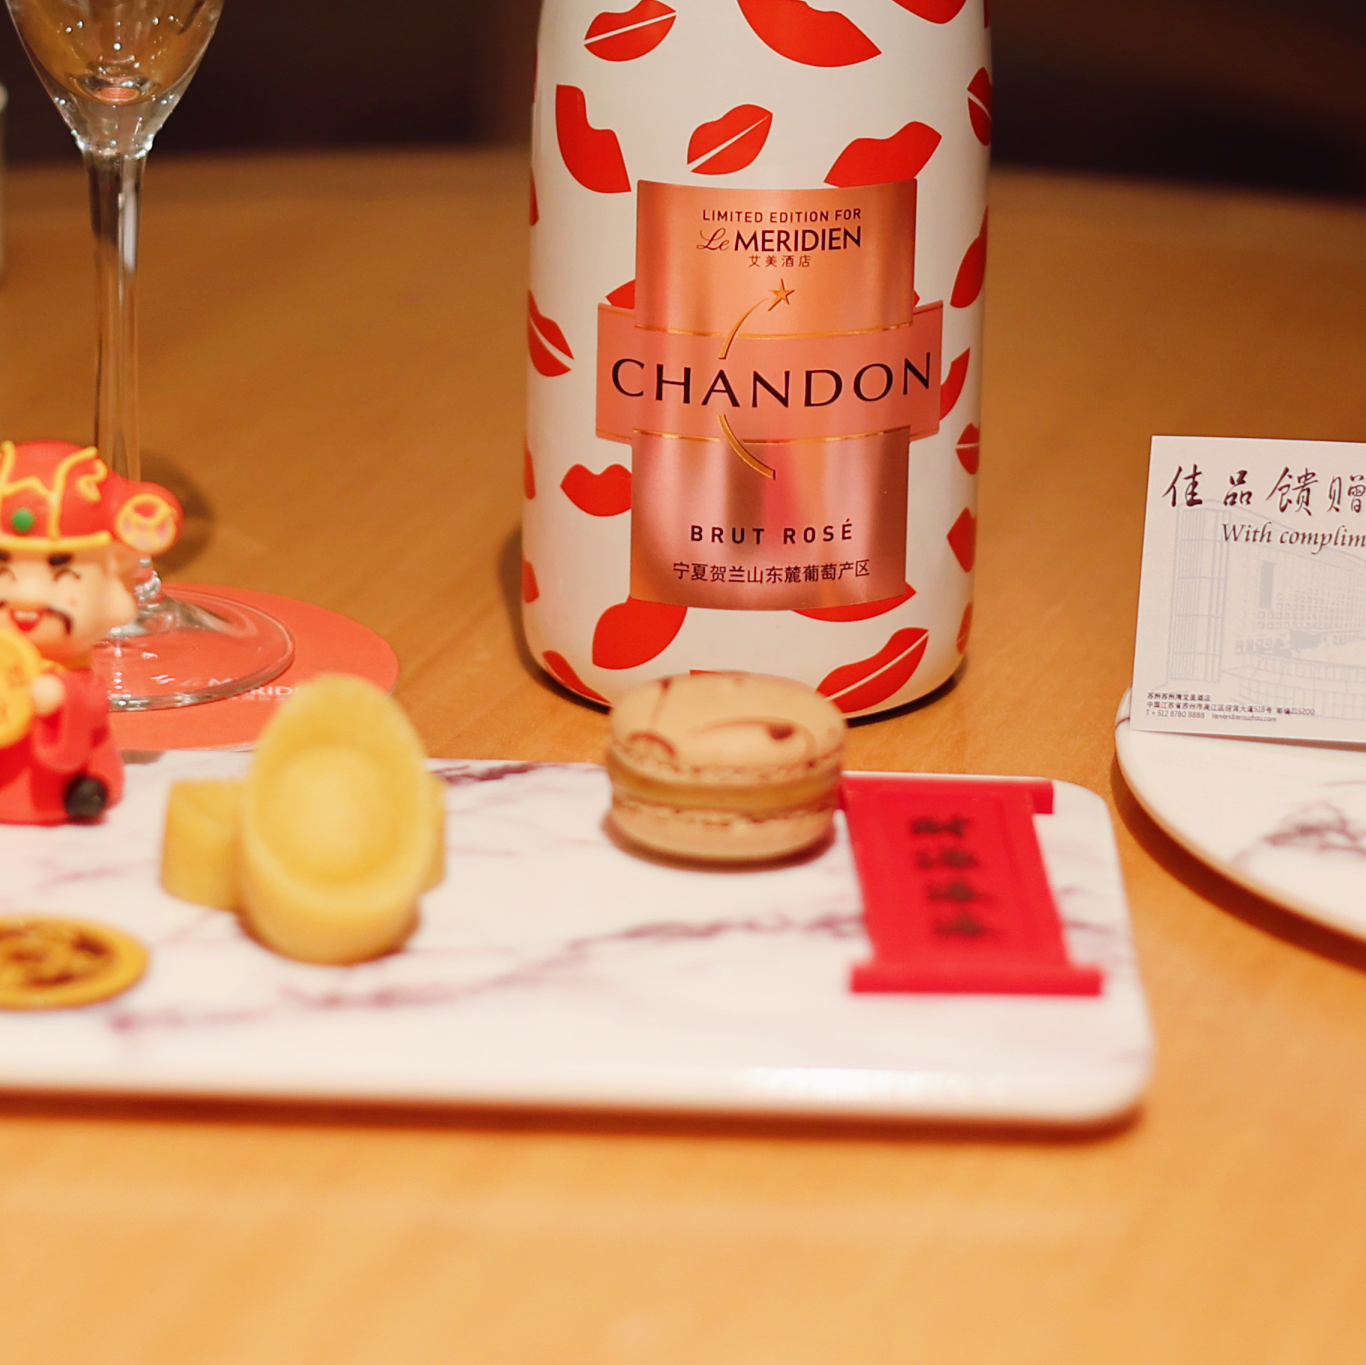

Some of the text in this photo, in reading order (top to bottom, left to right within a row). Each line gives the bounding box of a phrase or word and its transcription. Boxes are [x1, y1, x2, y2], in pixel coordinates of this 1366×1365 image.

[702, 208, 862, 224] LIMITED EDITION FOR
[696, 225, 862, 252] Le MERIDIEN
[748, 254, 812, 268] 艾美酒店
[611, 351, 932, 409] CHANDON
[690, 517, 853, 546] BRUT ROSÉ
[1221, 521, 1272, 545] With
[672, 558, 871, 584] 宁夏贺兰山东麓葡萄产区
